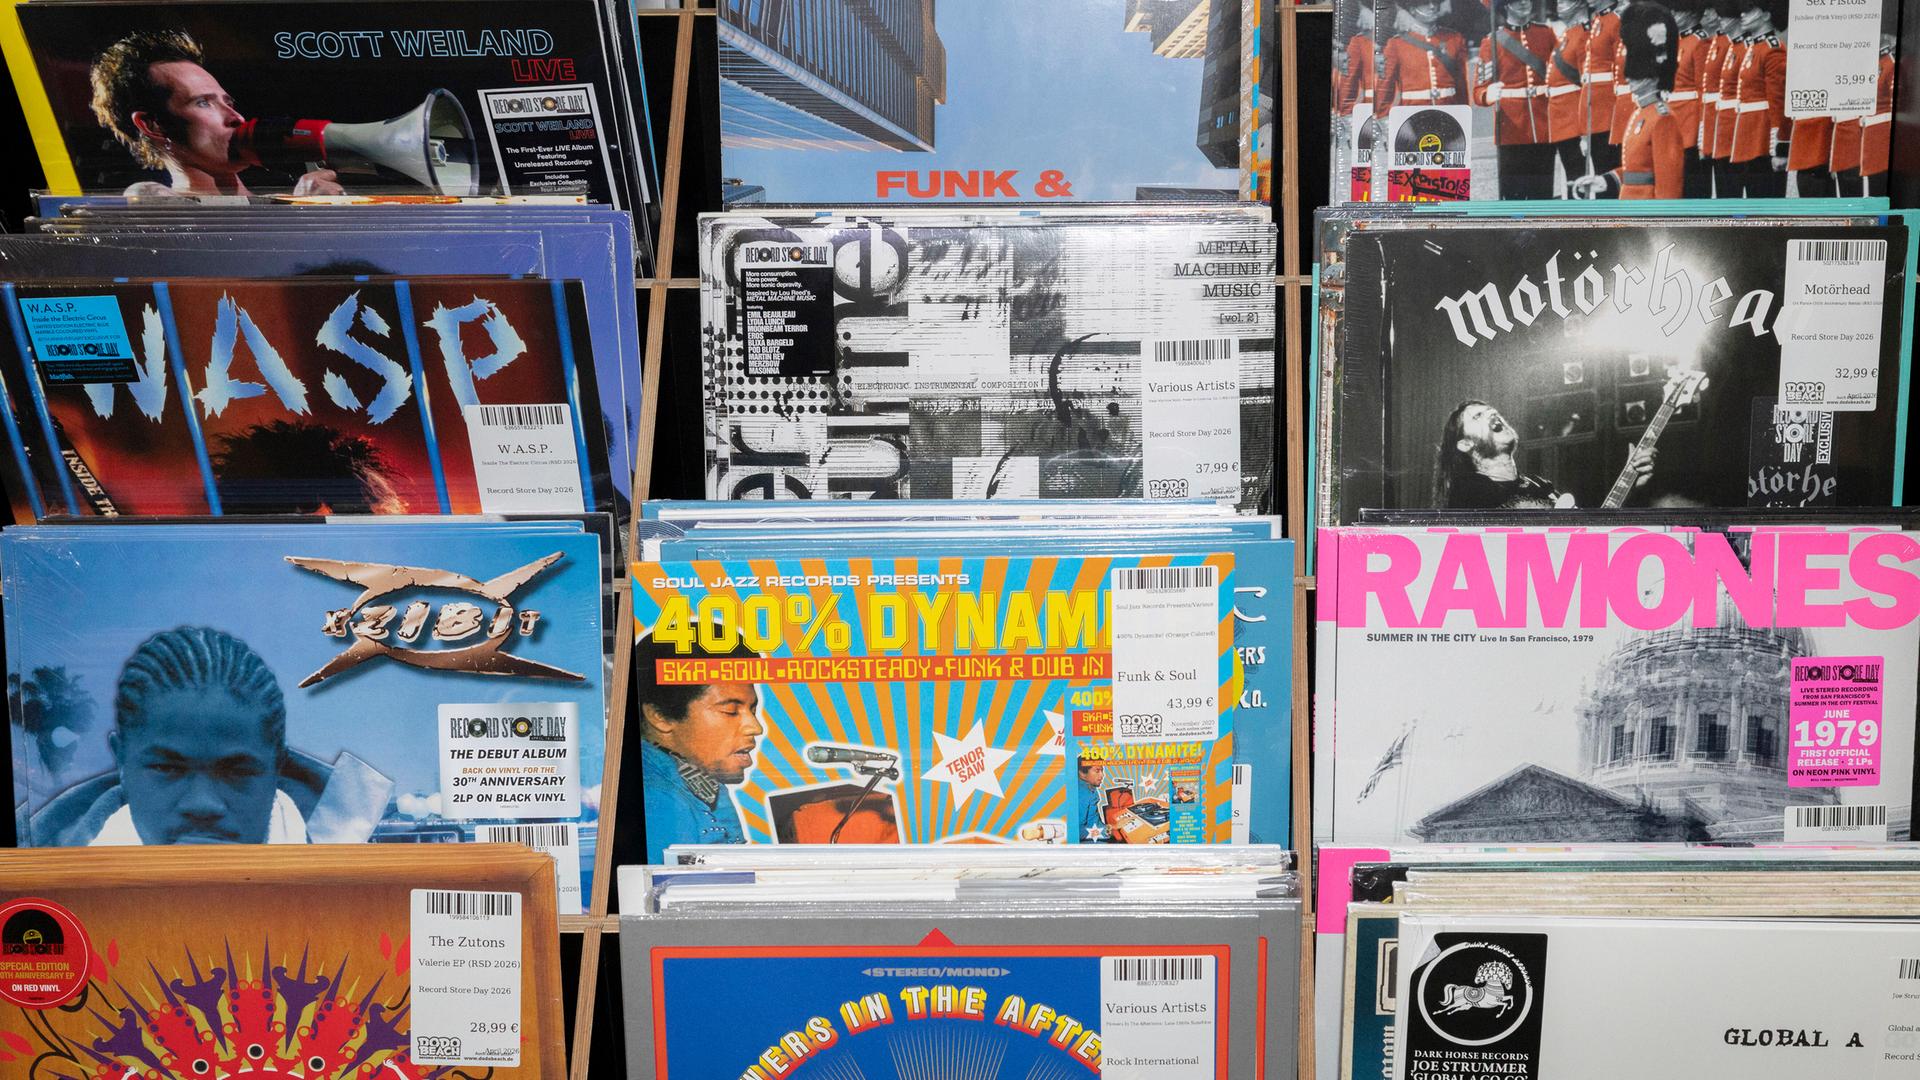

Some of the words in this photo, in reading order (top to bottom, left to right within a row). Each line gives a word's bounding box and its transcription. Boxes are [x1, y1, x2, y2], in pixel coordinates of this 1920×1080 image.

[275, 30, 385, 59] SCOTT
[391, 28, 554, 57] WEILAND
[512, 58, 577, 82] LIVE
[1835, 75, 1866, 85] 35,99
[1869, 74, 1875, 84] €
[876, 170, 1020, 199] FUNK
[1034, 169, 1075, 198] &
[1199, 240, 1262, 254] METAL
[1174, 263, 1261, 277] MACHINE
[1202, 283, 1261, 298] MUSIC
[1805, 284, 1870, 295] Motörhead
[27, 303, 77, 313] W.A.S.P.
[1840, 334, 1853, 342] Day
[1835, 368, 1868, 379] 32,99
[1871, 368, 1879, 377] €
[981, 381, 1039, 389] COMPOSITION
[1149, 382, 1192, 392] Various
[1196, 381, 1235, 391] Artists
[1786, 391, 1824, 401] BEACH
[498, 444, 553, 453] W.A.S.P.
[1196, 463, 1228, 474] 37,99
[1232, 462, 1239, 471] €
[652, 577, 705, 589] SOUL
[710, 576, 759, 588] JAZZ
[765, 575, 860, 587] RECORDS
[866, 574, 970, 586] PRESENTS
[1337, 532, 1920, 630] RAMONES
[652, 591, 852, 655] 400%
[1367, 633, 1413, 642] SUMMER
[1416, 634, 1428, 642] IN
[1431, 634, 1450, 642] THE
[1454, 634, 1476, 642] CITY
[1528, 635, 1570, 643] Francisco,
[1032, 656, 1075, 677] DUB
[1082, 655, 1104, 676] IN
[1117, 671, 1150, 682] Funk
[1154, 671, 1164, 681] &
[1170, 669, 1197, 680] Soul
[1167, 698, 1202, 709] 43,99
[1206, 697, 1213, 707] €
[1823, 710, 1850, 719] JUNE
[547, 717, 566, 737] DAY
[1794, 720, 1878, 747] 1979
[450, 750, 474, 759] THE
[478, 749, 519, 759] DEBUT
[522, 749, 567, 758] ALBUM
[1081, 744, 1123, 760] 400%
[1128, 743, 1201, 759] DYNAMITE!
[1801, 749, 1826, 757] FIRST
[1829, 749, 1870, 757] OFFICIAL
[946, 746, 985, 775] TENOR
[1797, 759, 1839, 767] RELEASE
[1856, 758, 1872, 766] LPs
[959, 759, 985, 783] SAW
[453, 777, 477, 786] 30TH
[480, 776, 566, 786] ANNIVERSARY
[453, 794, 473, 802] 2LP
[477, 794, 492, 802] ON
[496, 794, 531, 802] BLACK
[534, 794, 566, 802] VINYL
[429, 936, 454, 947] The
[458, 936, 505, 948] Zutons
[0, 962, 33, 971] SPECIAL
[36, 962, 69, 970] EDITION
[418, 959, 450, 967] Valerie
[468, 959, 491, 968] (RSD
[494, 960, 520, 969] 2026)
[12, 984, 23, 992] ON
[24, 984, 38, 992] RED
[39, 984, 60, 992] VINYL
[473, 987, 489, 995] Day
[1106, 1003, 1157, 1014] Various
[1162, 1002, 1206, 1013] Artists
[470, 1022, 506, 1034] 28,99
[511, 1023, 518, 1033] €
[840, 992, 894, 1036] IN
[900, 985, 987, 1020] THE
[994, 994, 1101, 1074] AFTE
[417, 1036, 461, 1047] DODO
[1724, 1028, 1829, 1047] GLOBAL
[1845, 1032, 1864, 1048] A
[419, 1046, 461, 1056] BEACH
[1415, 1050, 1443, 1058] DARK
[1445, 1050, 1479, 1060] HORSE
[1482, 1052, 1529, 1060] RECORDS
[1107, 1058, 1131, 1066] Rock
[1134, 1056, 1199, 1065] International
[1412, 1060, 1440, 1072] JOE
[1442, 1062, 1527, 1073] STRUMMER
